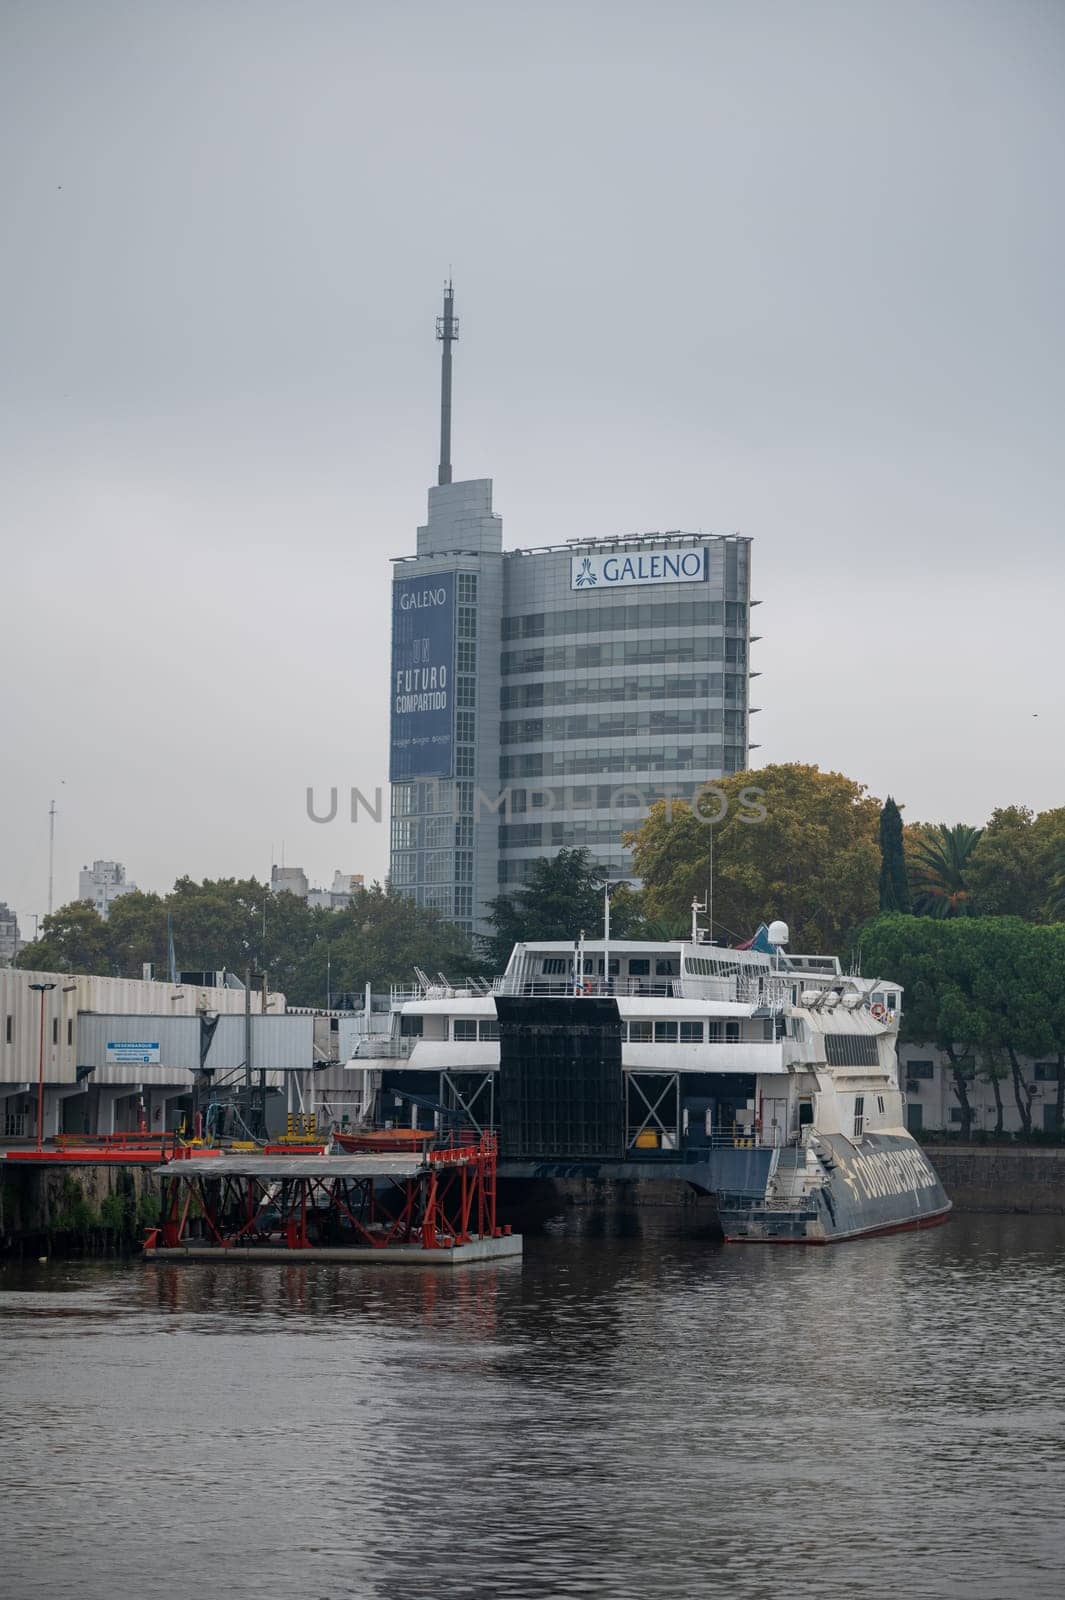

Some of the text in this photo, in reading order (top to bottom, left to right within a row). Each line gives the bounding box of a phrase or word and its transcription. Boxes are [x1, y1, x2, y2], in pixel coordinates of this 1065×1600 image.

[603, 553, 701, 581] GALENO
[400, 588, 447, 610] GALENO
[396, 665, 447, 693] FUTURO
[396, 691, 447, 714] COMPARTIDO
